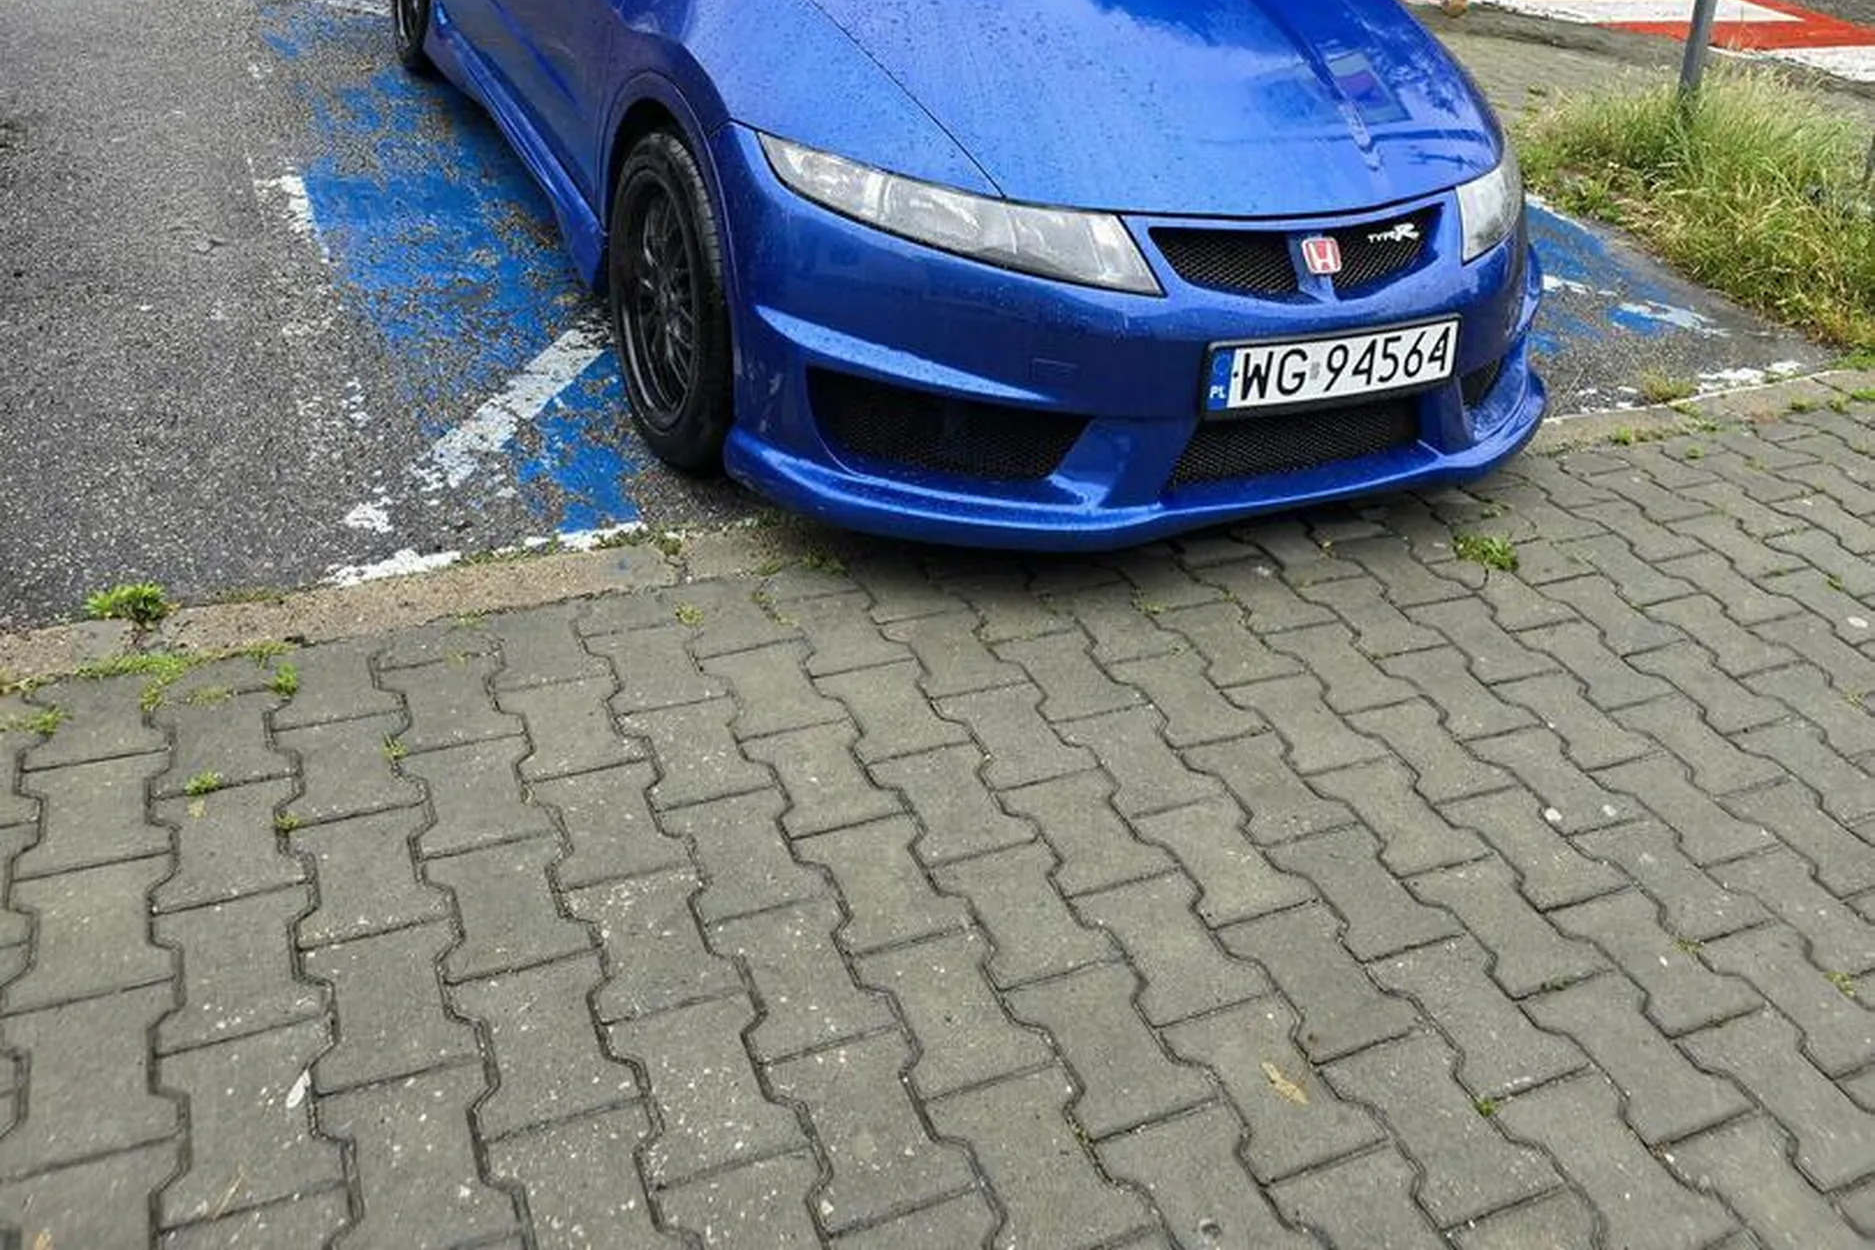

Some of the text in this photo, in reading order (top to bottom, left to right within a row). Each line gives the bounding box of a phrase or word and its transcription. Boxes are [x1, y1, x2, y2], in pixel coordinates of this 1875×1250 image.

[1240, 326, 1451, 401] WG 94564
[1209, 385, 1226, 399] PL
